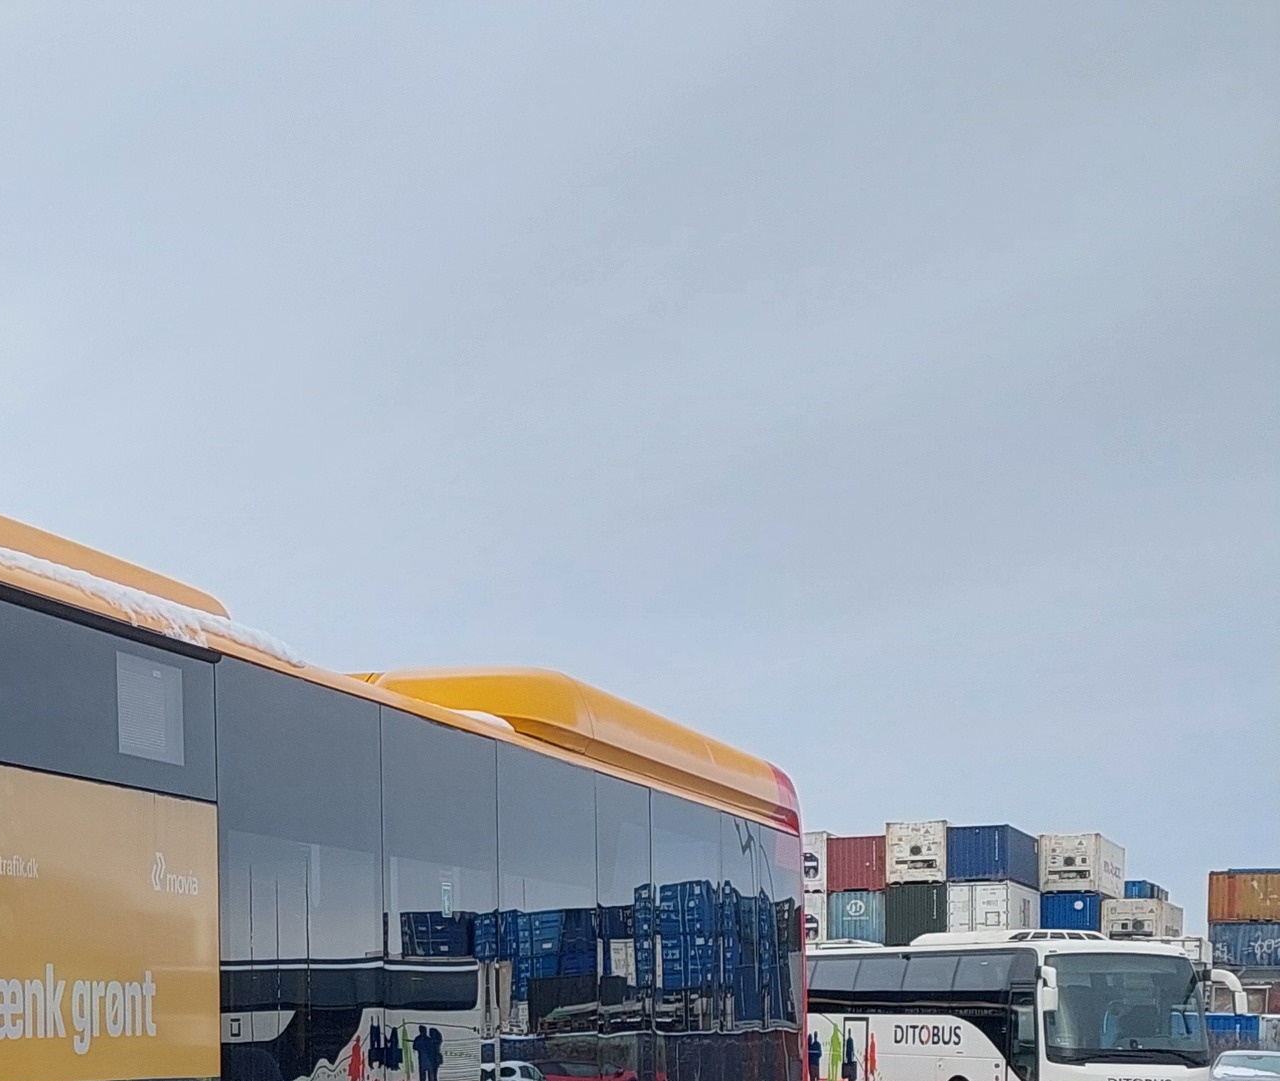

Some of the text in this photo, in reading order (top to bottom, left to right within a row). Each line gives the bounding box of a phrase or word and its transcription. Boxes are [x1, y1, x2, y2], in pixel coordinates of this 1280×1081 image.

[166, 869, 198, 896] movia
[72, 970, 157, 1056] grønt
[893, 1024, 962, 1046] DITOBUS
